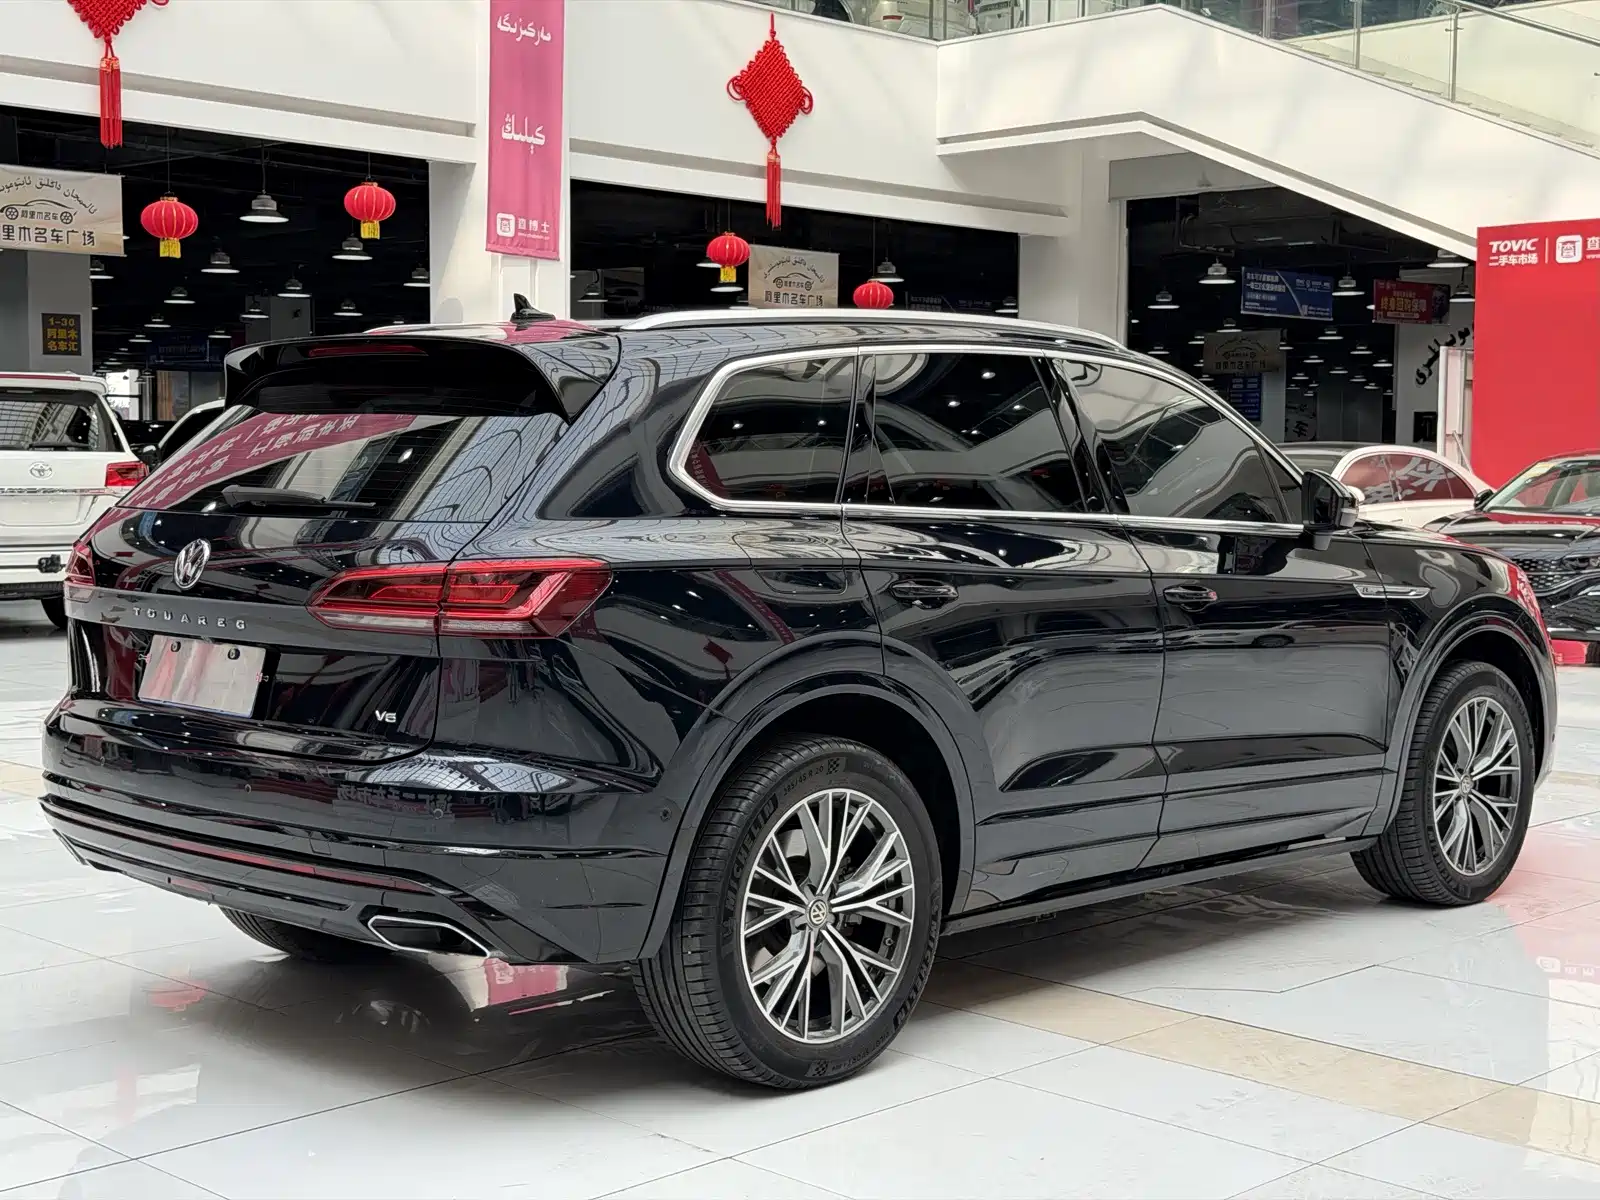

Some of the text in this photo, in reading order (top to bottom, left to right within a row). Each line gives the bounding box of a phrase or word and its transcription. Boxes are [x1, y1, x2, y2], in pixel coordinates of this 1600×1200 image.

[1489, 238, 1540, 254] TOVIC
[1488, 253, 1539, 267] 二手车市场
[133, 607, 246, 630] TOUAREG
[375, 710, 396, 722] V6
